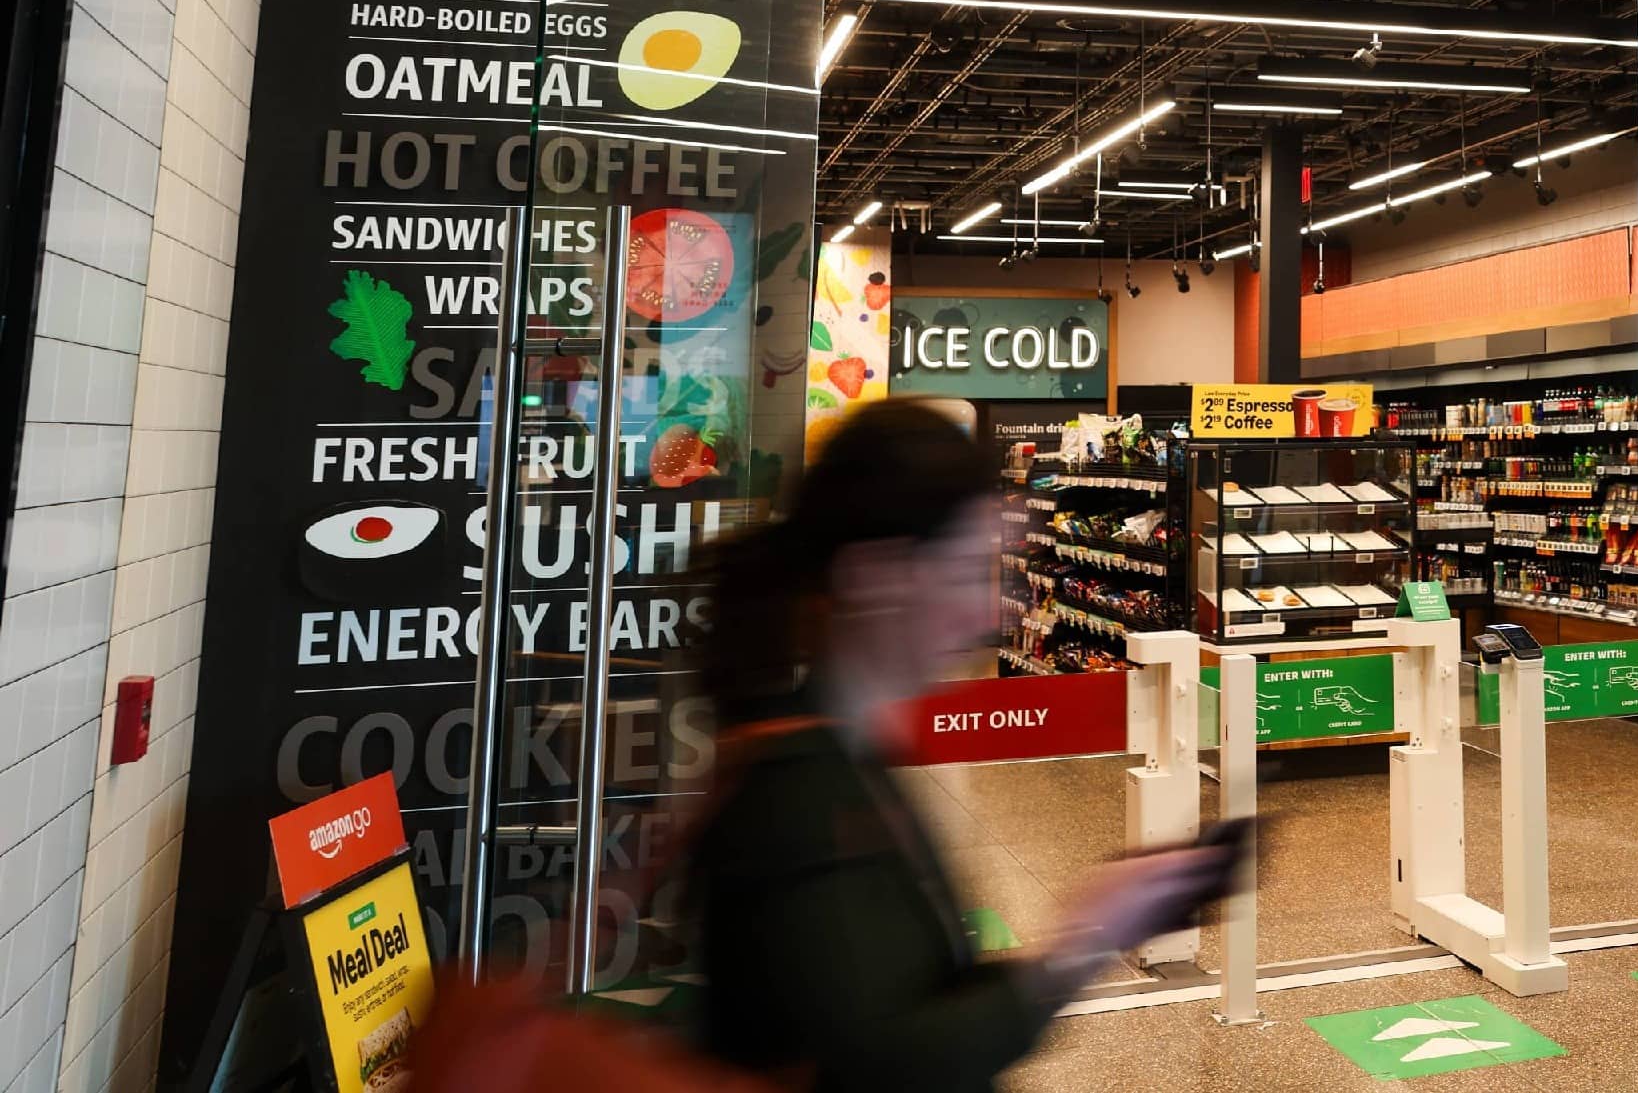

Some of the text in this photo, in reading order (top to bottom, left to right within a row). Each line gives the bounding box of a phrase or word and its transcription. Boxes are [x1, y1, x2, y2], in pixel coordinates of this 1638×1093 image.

[351, 4, 607, 38] HARD-BOILED EGGS
[345, 53, 603, 108] OATMEAL
[323, 130, 737, 198] HOT COFFEE
[904, 325, 1099, 370] ICE COLD
[1225, 415, 1273, 429] Coffee
[1227, 398, 1294, 414] Espresso
[995, 422, 1063, 434] Fountain dri
[312, 434, 647, 483] FRESH RUT
[1564, 649, 1627, 662] ENTER WITH:
[1264, 669, 1334, 683] ENTER WITH:
[933, 708, 1049, 733] EXIT ONLY
[276, 696, 717, 804] COOKES
[308, 806, 371, 853] amazon go
[327, 912, 410, 996] Meal Deal
